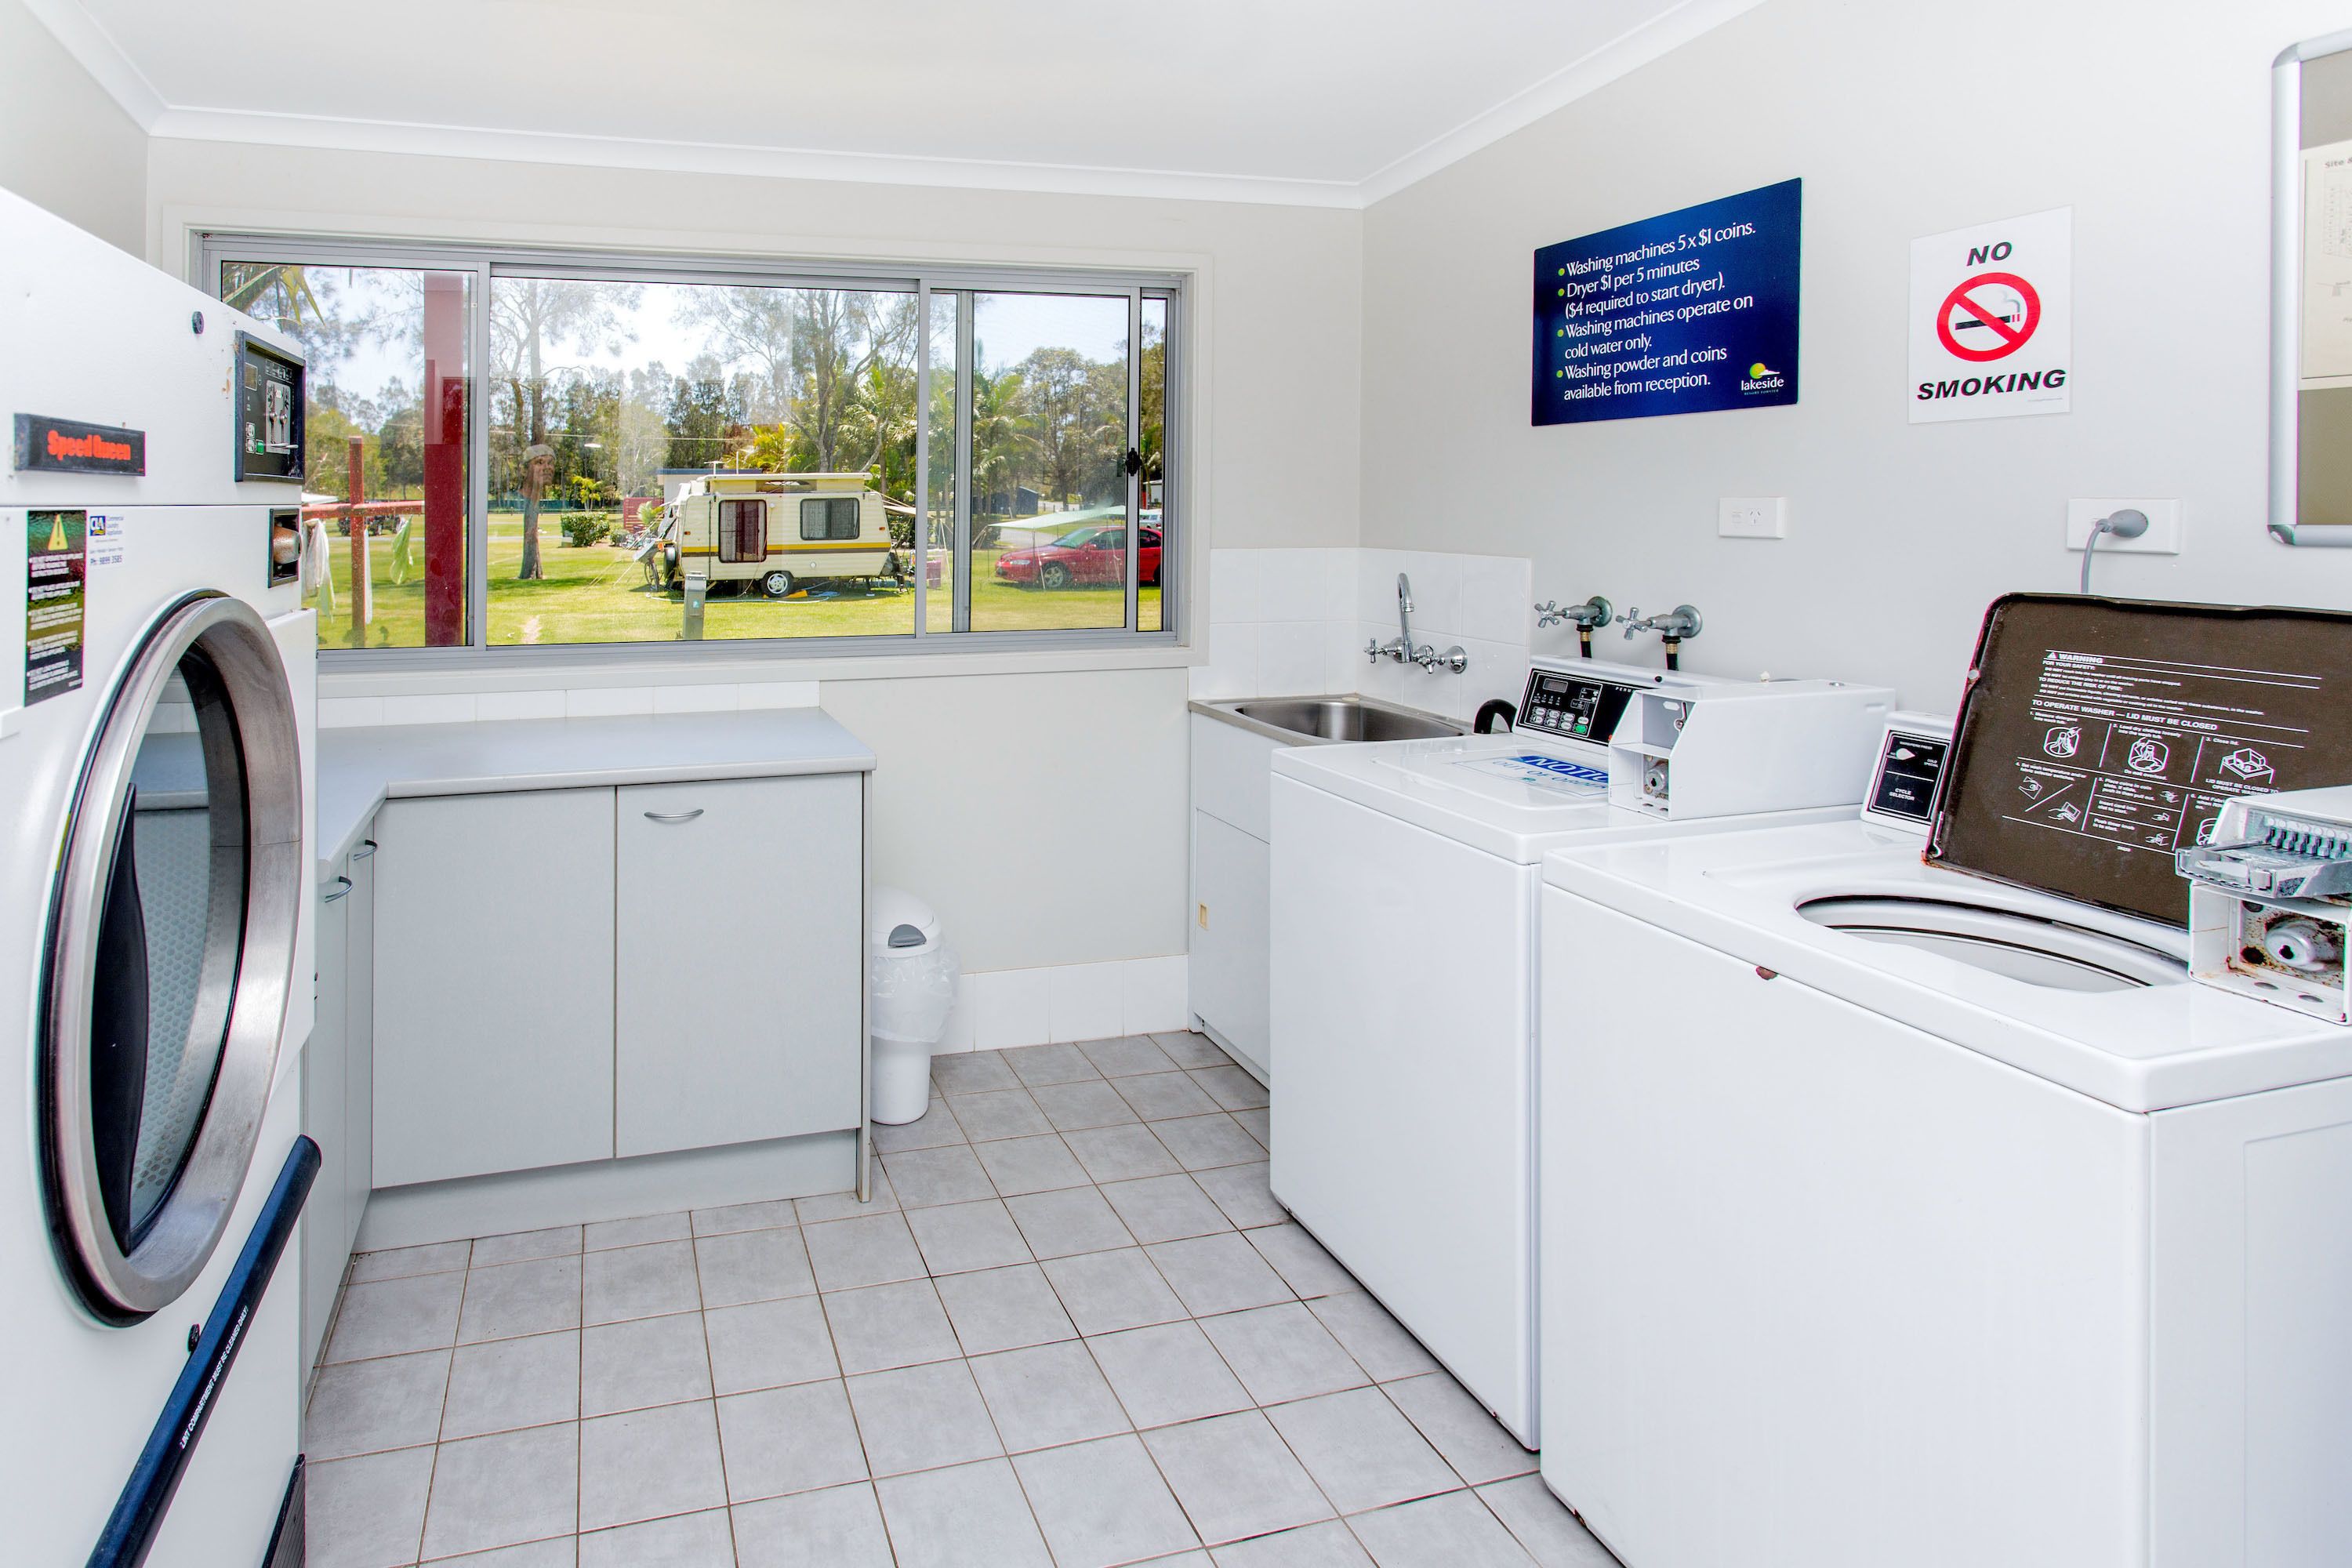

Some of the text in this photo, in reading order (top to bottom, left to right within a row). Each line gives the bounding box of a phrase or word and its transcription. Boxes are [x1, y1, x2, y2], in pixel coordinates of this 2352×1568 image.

[1566, 222, 1756, 277] Washing machines 5 x $1 coins.
[1966, 241, 2013, 267] NO
[1567, 259, 1700, 299] Dryer $1 per 5 minutes
[1565, 271, 1726, 320] ($4 required to start dryer).
[1565, 295, 1753, 338] Washing machines operate on
[1565, 332, 1653, 359] cold water only.
[1564, 346, 1728, 379] Washing powder and coins
[1563, 372, 1711, 401] available from reception.
[1741, 376, 1784, 390] lakeside
[1917, 369, 2067, 401] SMOKING
[47, 429, 131, 461] Speed Queen
[2059, 653, 2103, 664] WARNING
[2043, 702, 2080, 710] OPERATE
[2081, 706, 2115, 716] WASHER
[2180, 720, 2218, 730] CLOSED
[1889, 792, 1915, 800] SELECTOR
[187, 1378, 215, 1432] COMPARTMENT
[225, 1323, 241, 1354] CLEANED
